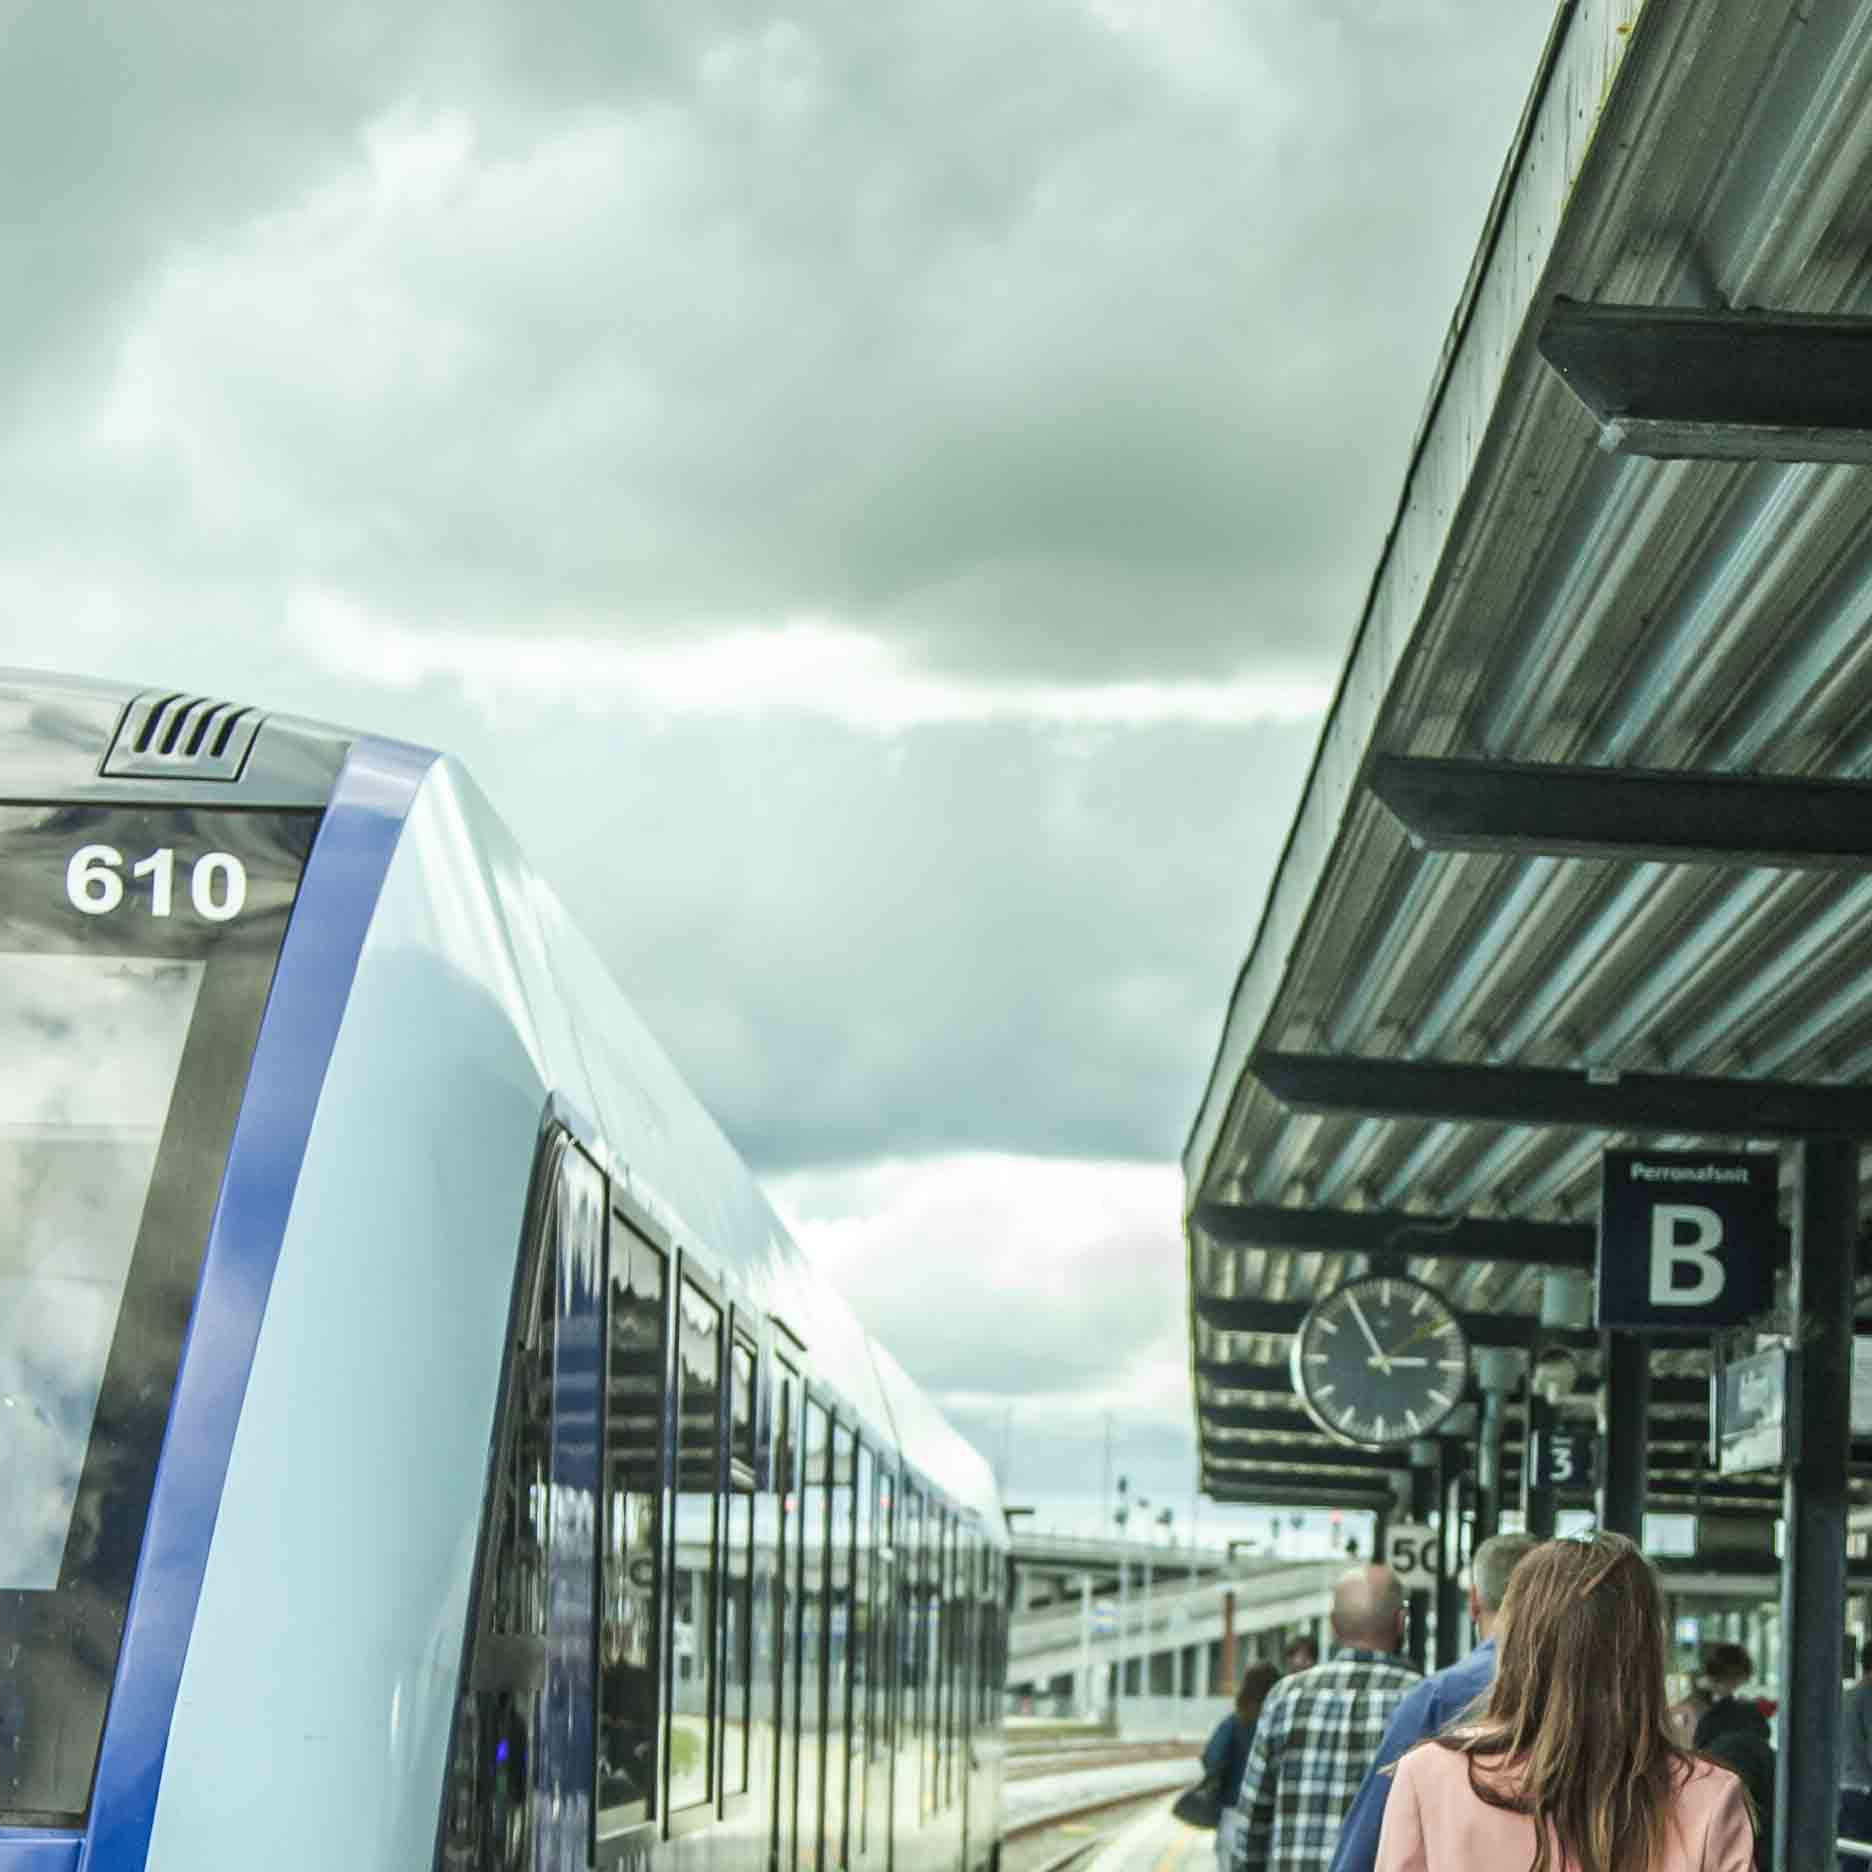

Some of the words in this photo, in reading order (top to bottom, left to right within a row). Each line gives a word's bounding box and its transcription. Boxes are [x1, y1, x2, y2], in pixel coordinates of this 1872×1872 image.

[66, 844, 247, 922] 610
[1630, 1162, 1751, 1184] Perronafsnit
[1649, 1204, 1726, 1307] B
[1549, 1447, 1574, 1481] 3
